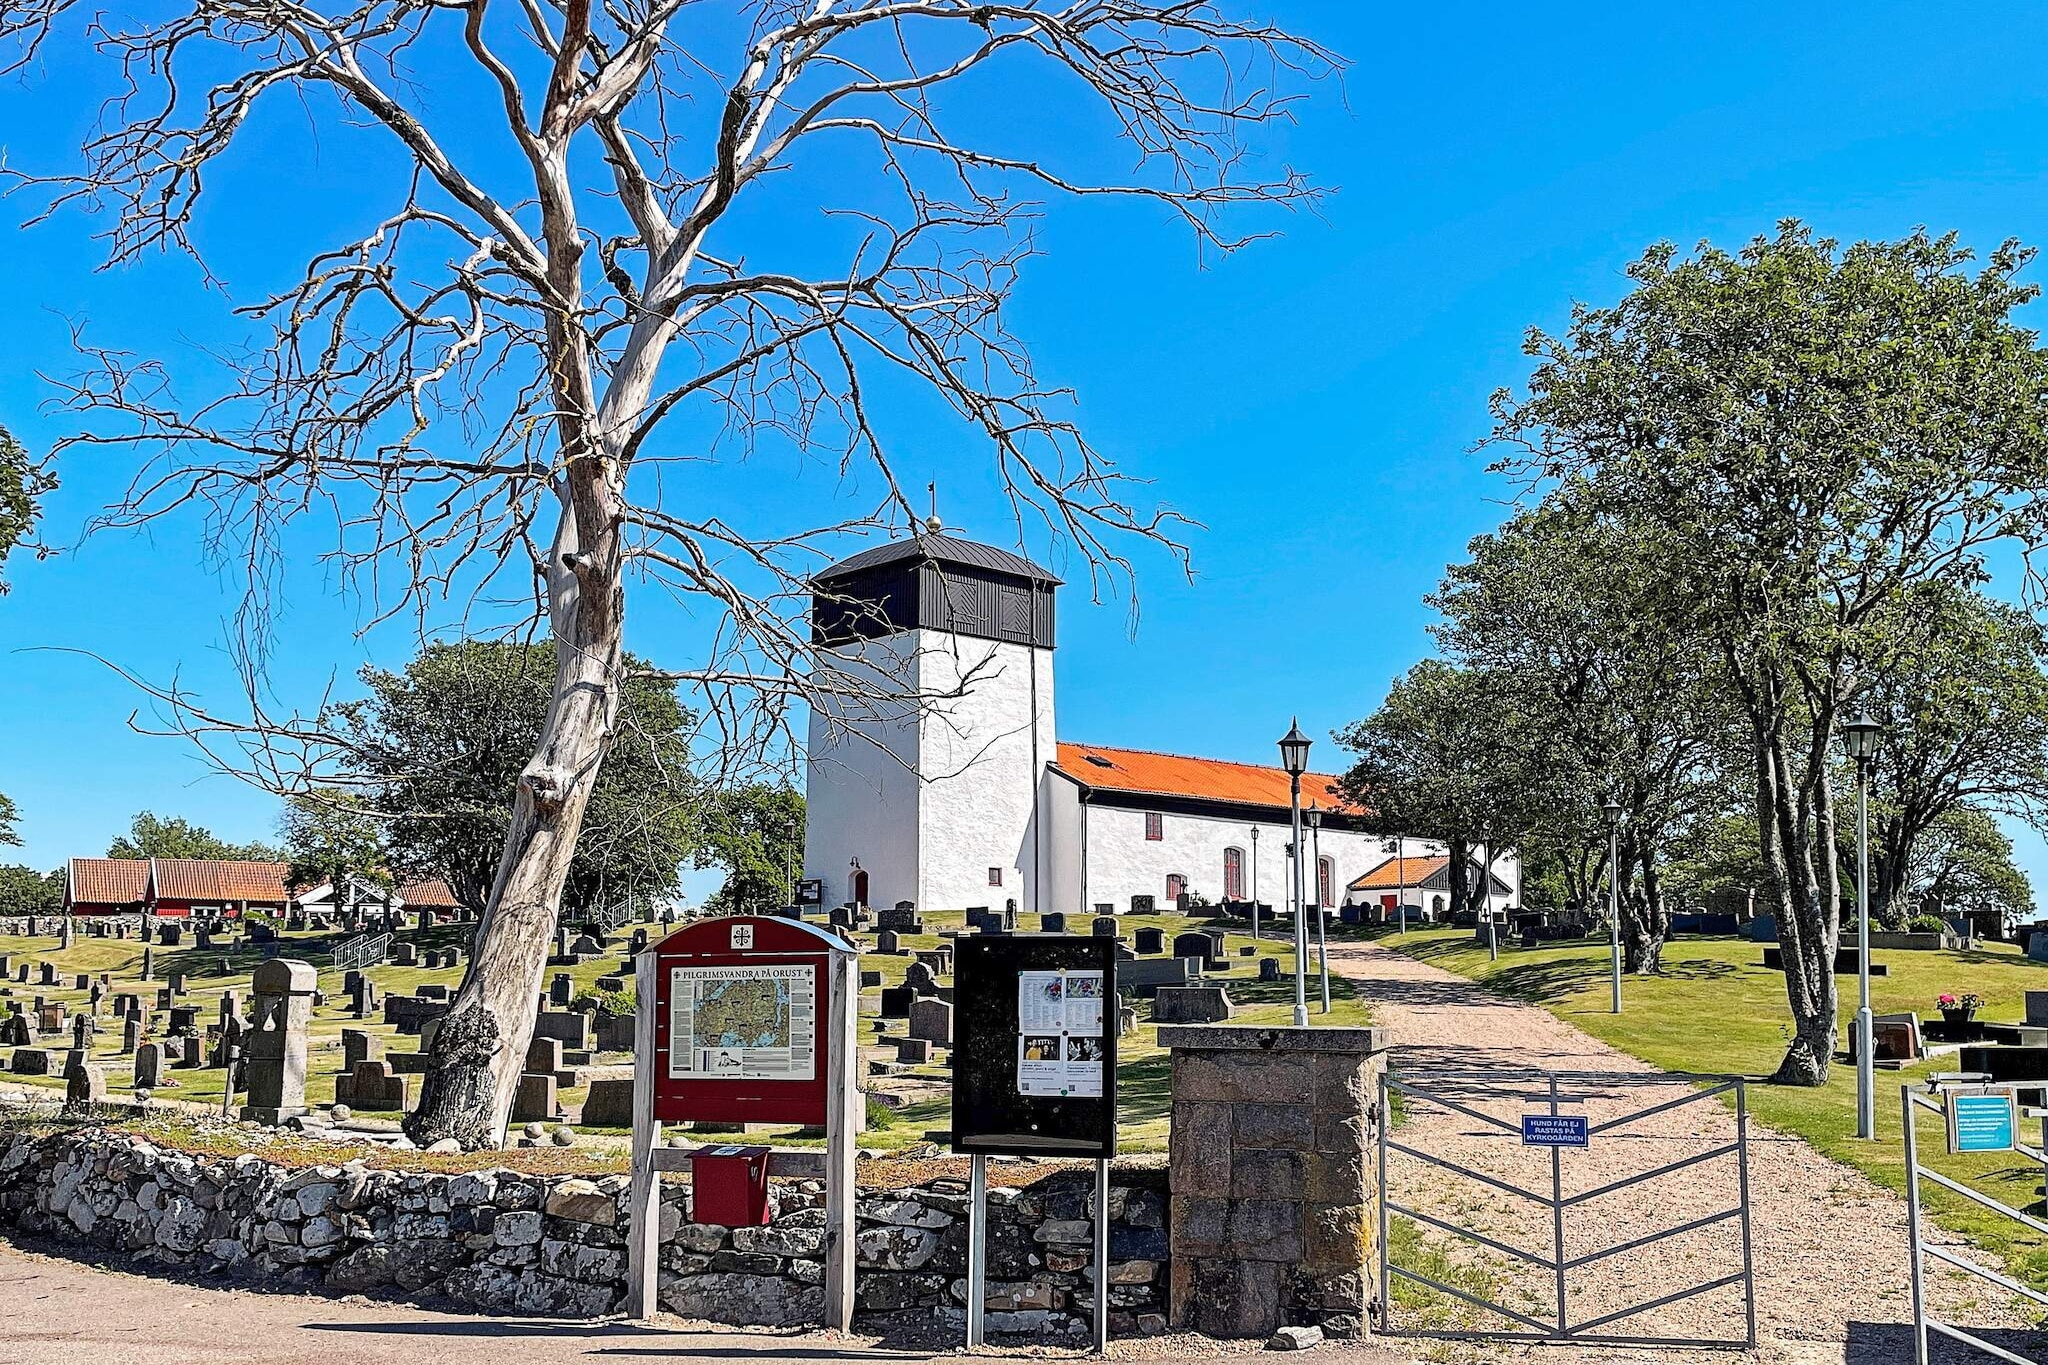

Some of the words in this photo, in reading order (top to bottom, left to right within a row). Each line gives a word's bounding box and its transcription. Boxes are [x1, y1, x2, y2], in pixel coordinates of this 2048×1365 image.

[683, 970, 760, 979] PILGRIMSVANDRA
[761, 968, 771, 978] PÅ
[772, 969, 803, 978] ORUST
